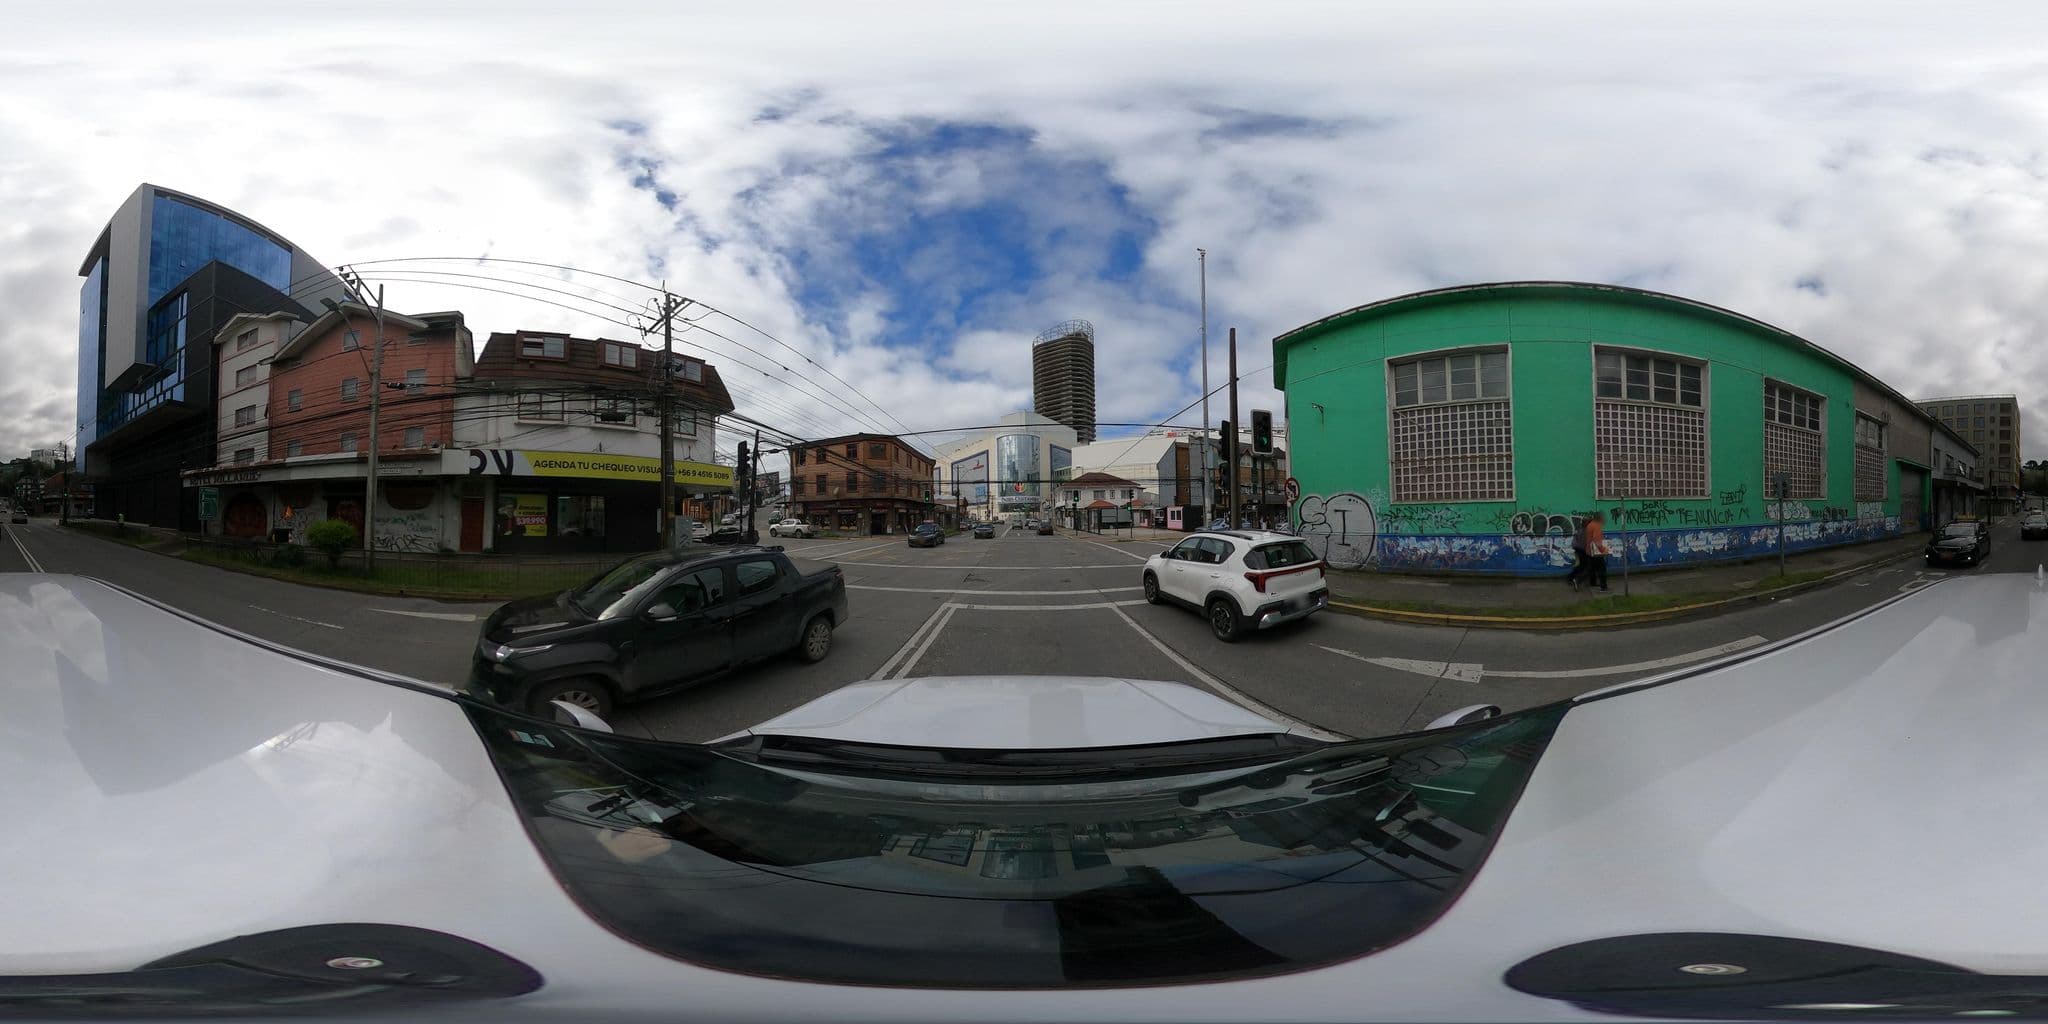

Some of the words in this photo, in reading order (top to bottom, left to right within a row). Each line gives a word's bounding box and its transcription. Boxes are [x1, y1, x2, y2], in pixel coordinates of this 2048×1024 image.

[533, 459, 576, 469] AGENDA
[577, 461, 589, 470] TU
[591, 462, 636, 473] CHEQUEO
[637, 465, 662, 475] VISUA
